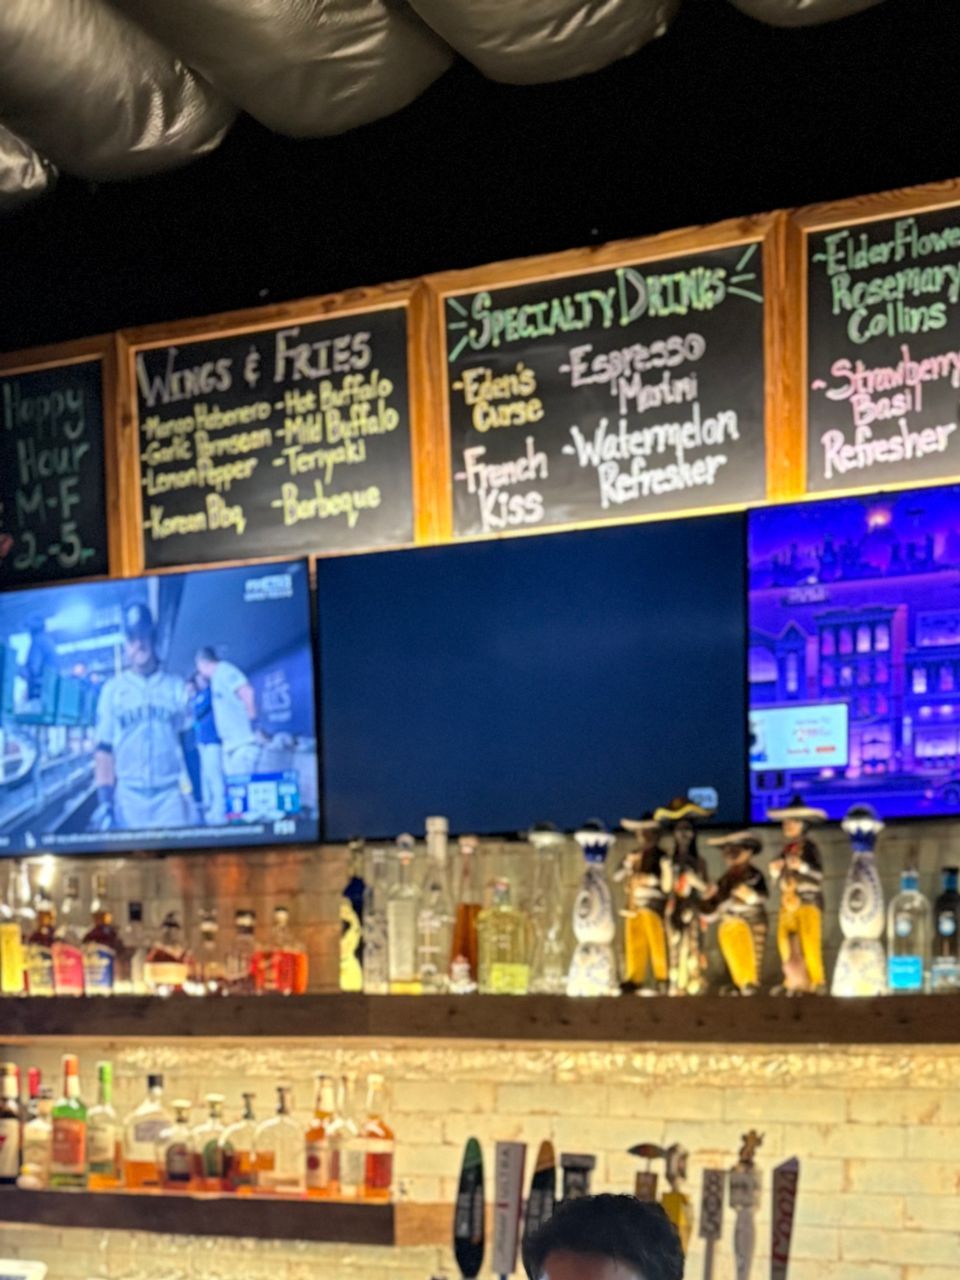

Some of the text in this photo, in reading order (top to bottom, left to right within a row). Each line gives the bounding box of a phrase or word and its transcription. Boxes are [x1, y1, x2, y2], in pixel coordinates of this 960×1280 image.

[469, 266, 727, 349] SPECIALTY DRINKS
[848, 299, 947, 344] Collins
[244, 345, 261, 388] &
[274, 328, 372, 382] FRIES
[3, 382, 85, 440] Happy
[319, 368, 393, 412] Buffalo
[850, 383, 922, 426] Basil
[325, 398, 399, 444] Buffalo
[473, 398, 544, 432] Curse
[17, 437, 90, 485] Hour
[821, 417, 957, 479] Refresher
[598, 455, 727, 509] Refresher
[478, 486, 545, 532] Kiss
